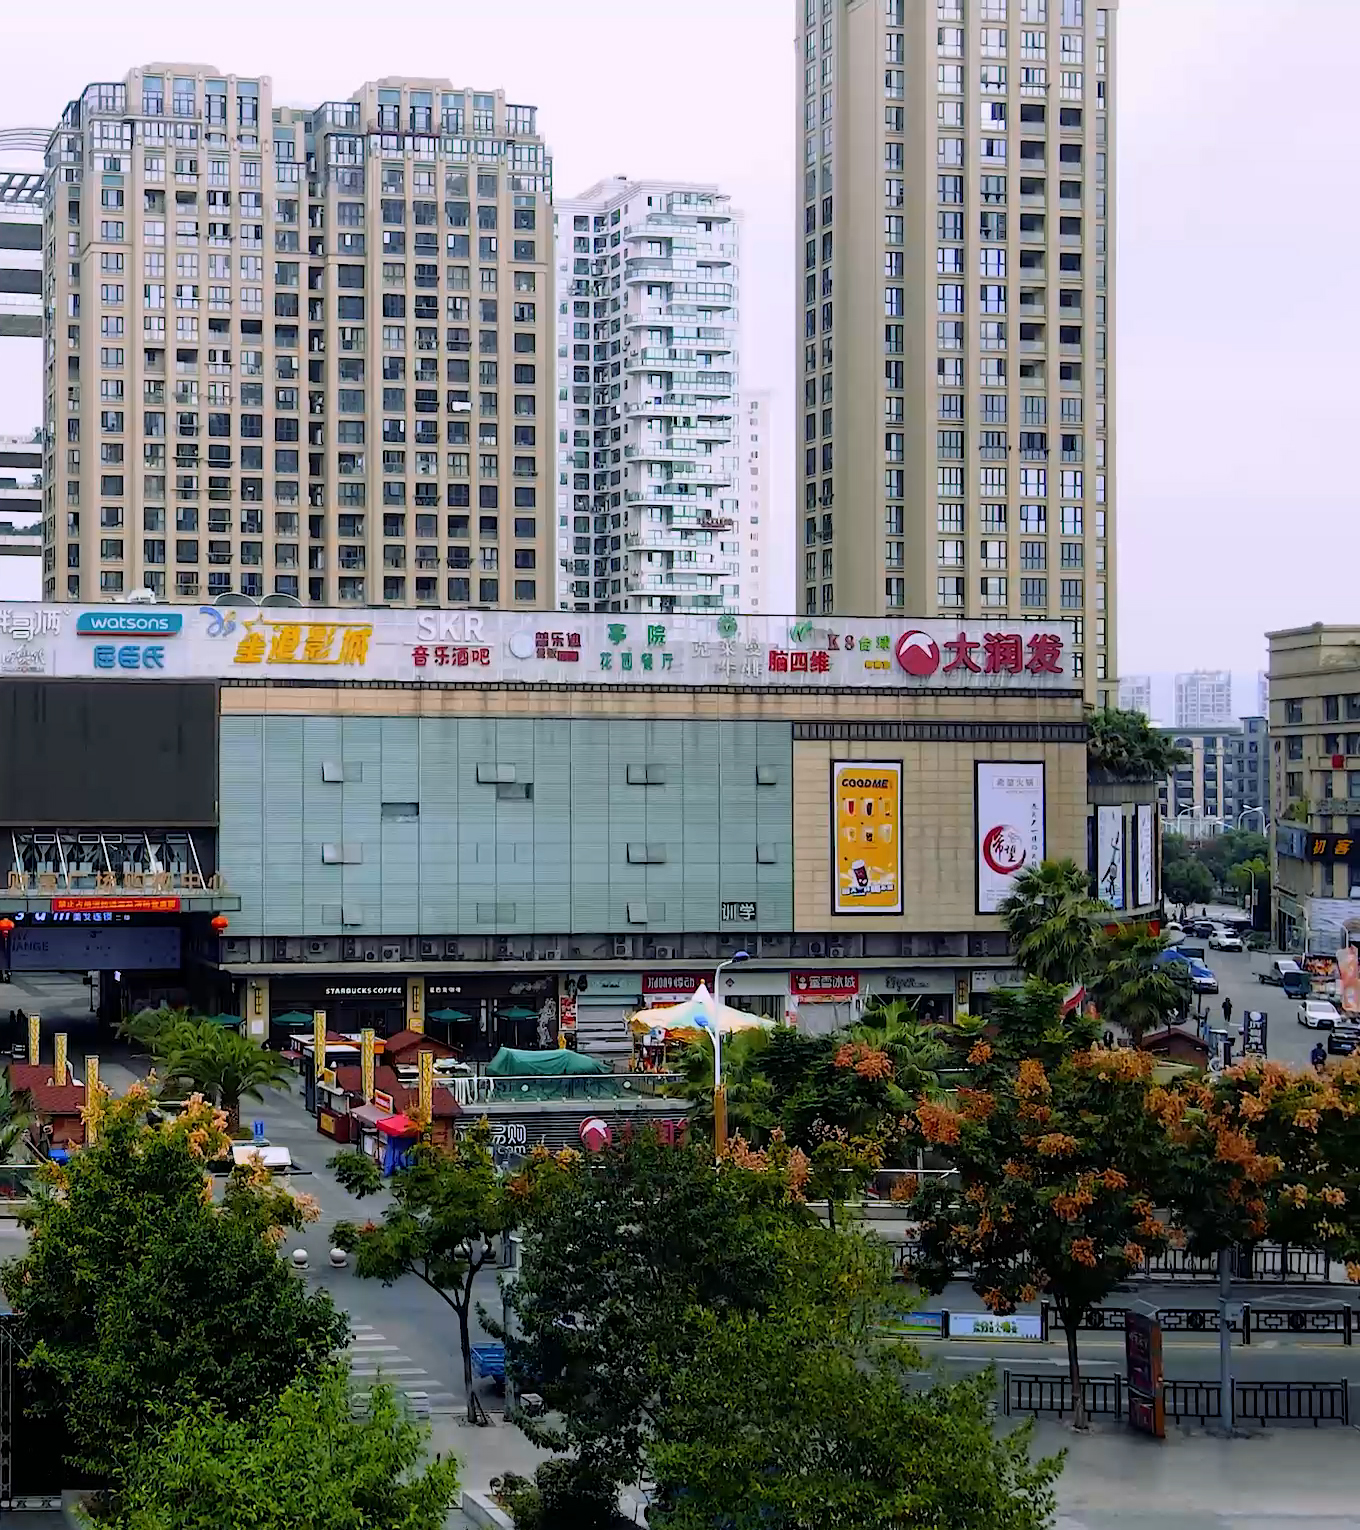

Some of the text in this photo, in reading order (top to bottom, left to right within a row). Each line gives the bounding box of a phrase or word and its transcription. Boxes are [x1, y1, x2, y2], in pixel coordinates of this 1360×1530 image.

[90, 615, 168, 631] watsons
[416, 612, 485, 642] SKR
[93, 645, 166, 669] 屈臣氏
[411, 646, 490, 667] 音乐酒吧
[768, 650, 830, 674] 脑四维
[942, 631, 1065, 674] 大润发
[842, 778, 889, 789] GOODME
[325, 987, 372, 995] STARBUCKS
